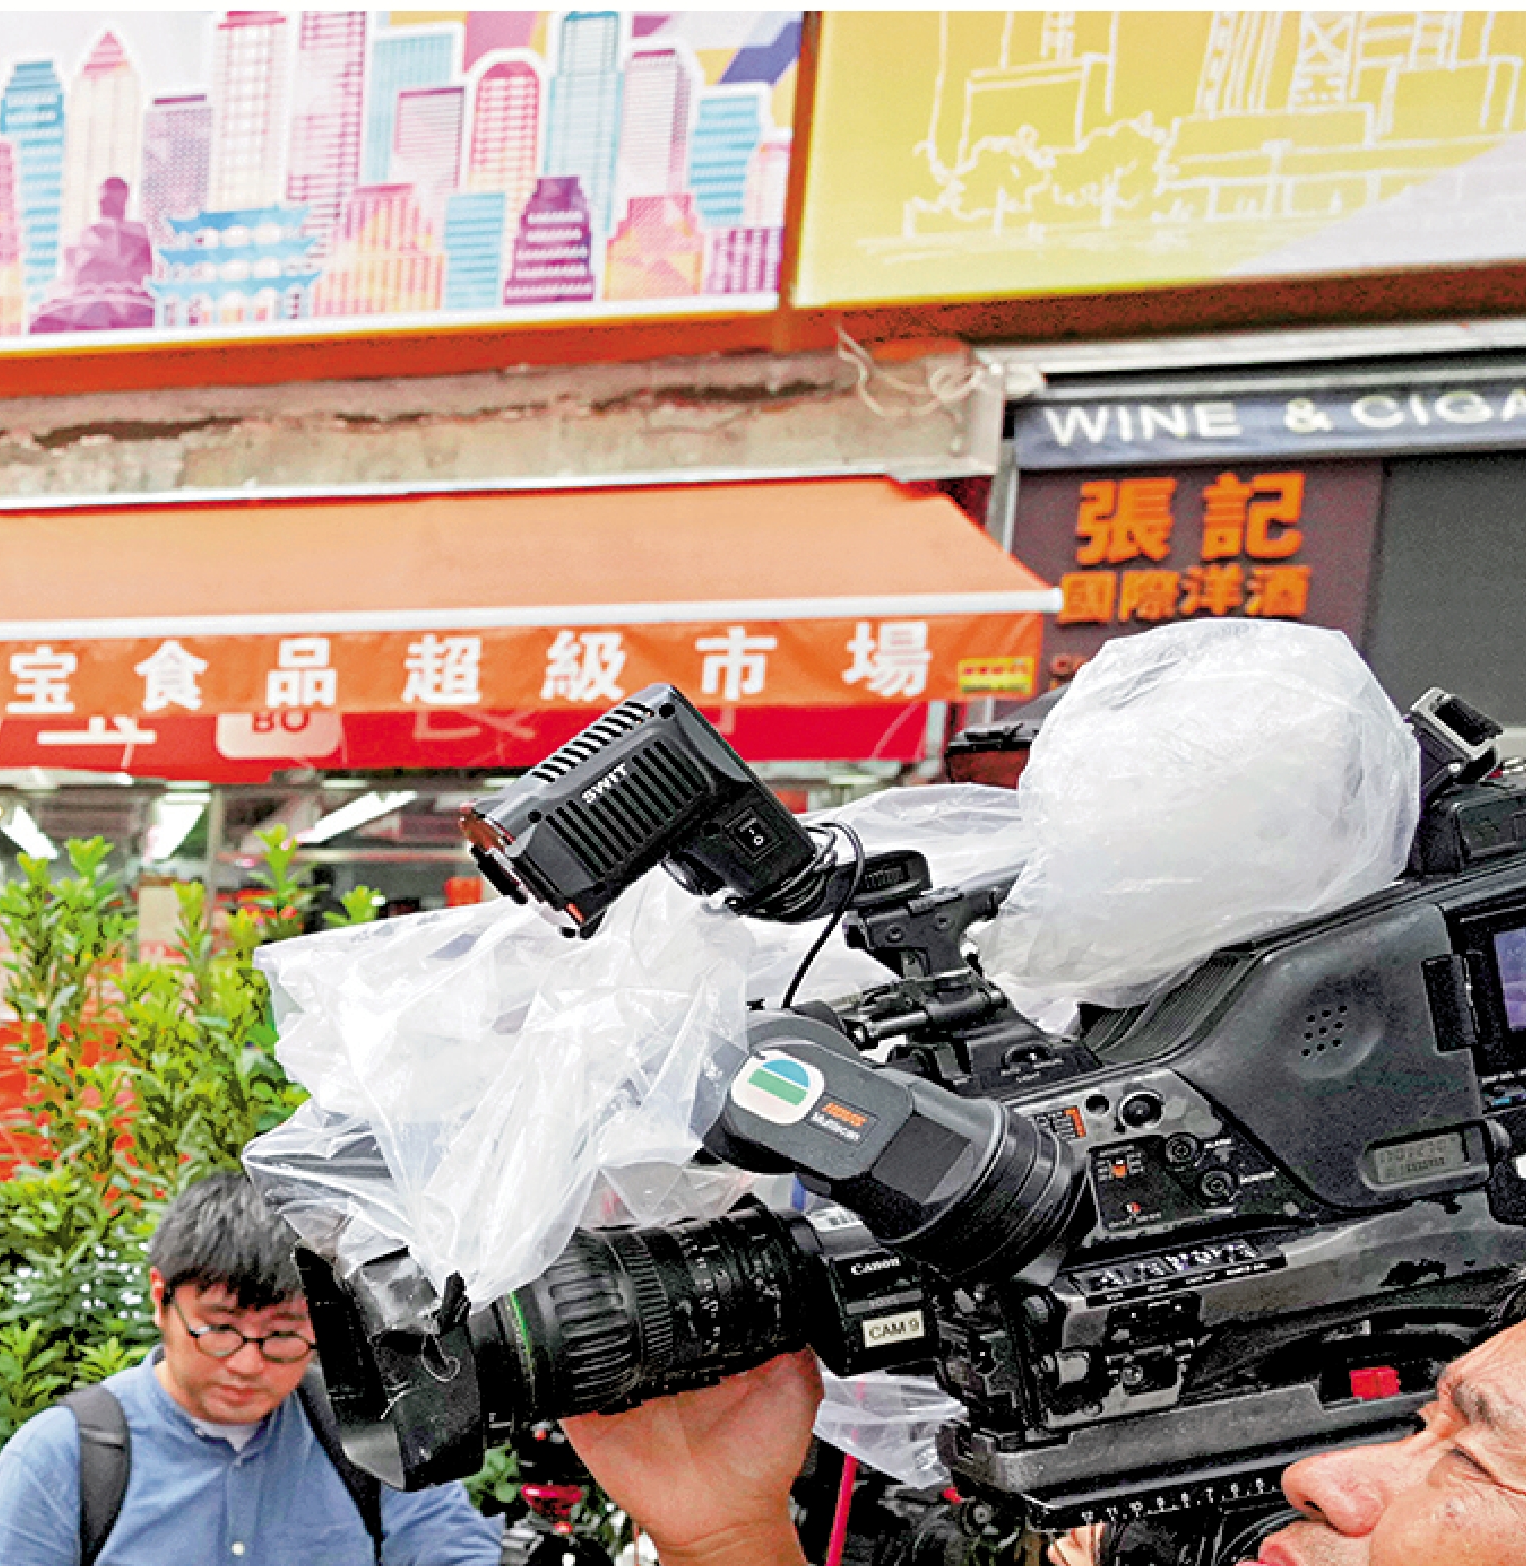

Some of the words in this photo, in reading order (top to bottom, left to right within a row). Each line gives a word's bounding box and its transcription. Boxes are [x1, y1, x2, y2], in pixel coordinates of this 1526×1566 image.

[1044, 402, 1243, 447] WINE
[1285, 397, 1334, 435] &
[1075, 471, 1307, 565] 張記
[1055, 563, 1313, 624] 國際洋酒
[581, 762, 627, 803] SWIT
